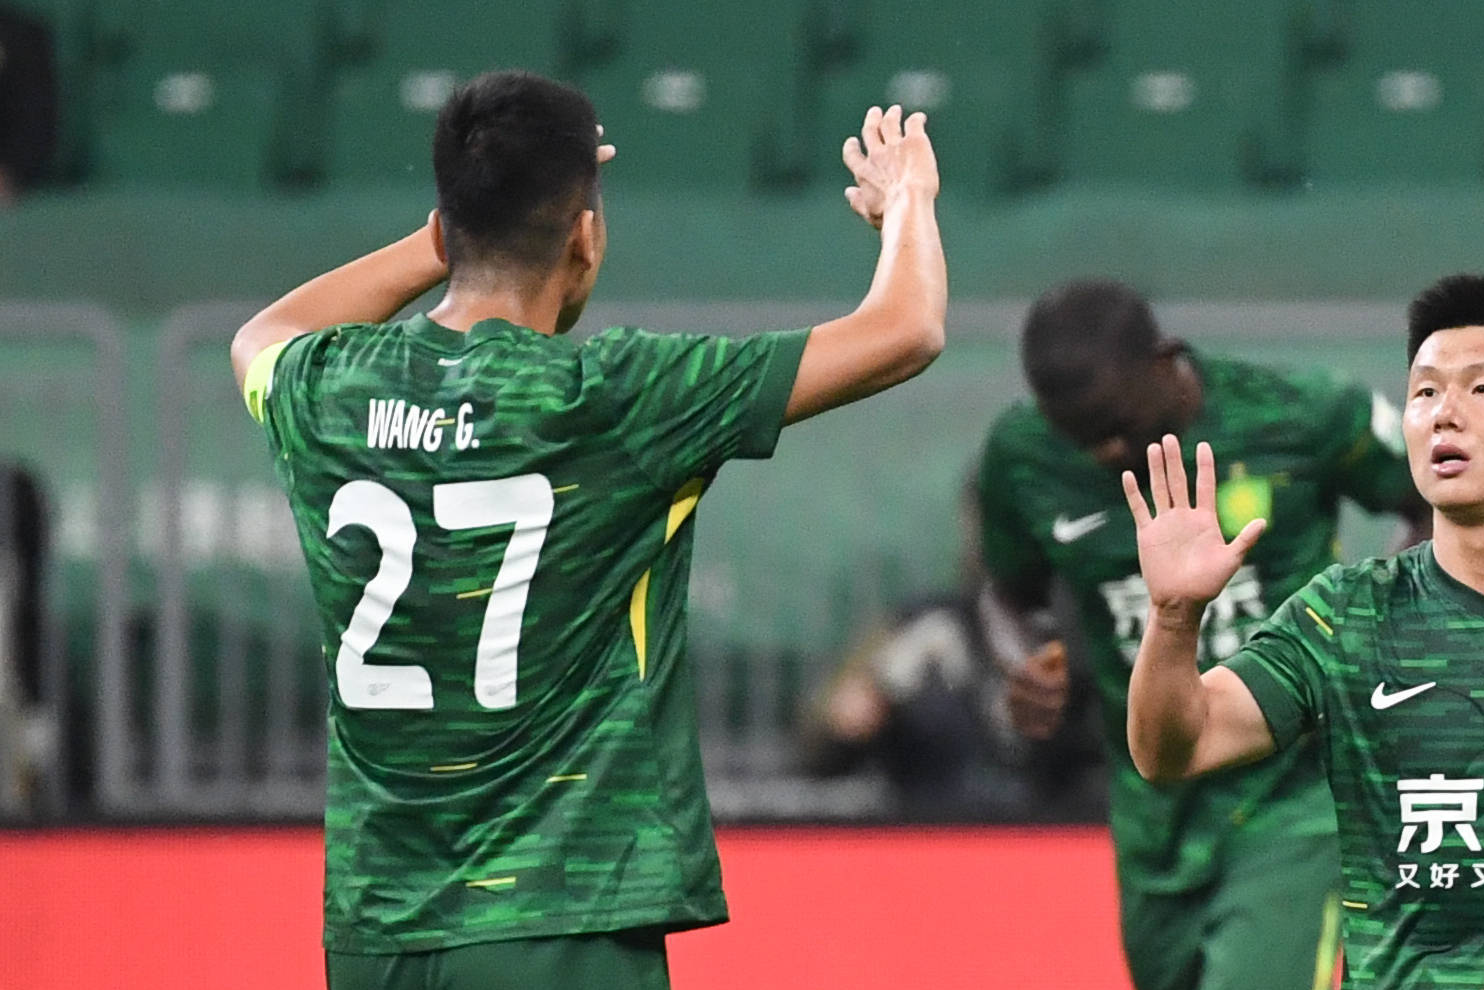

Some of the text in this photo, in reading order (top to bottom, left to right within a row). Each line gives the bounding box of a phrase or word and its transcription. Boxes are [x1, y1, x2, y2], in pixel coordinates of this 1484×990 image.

[366, 398, 480, 452] WANG G.
[326, 472, 555, 710] 27
